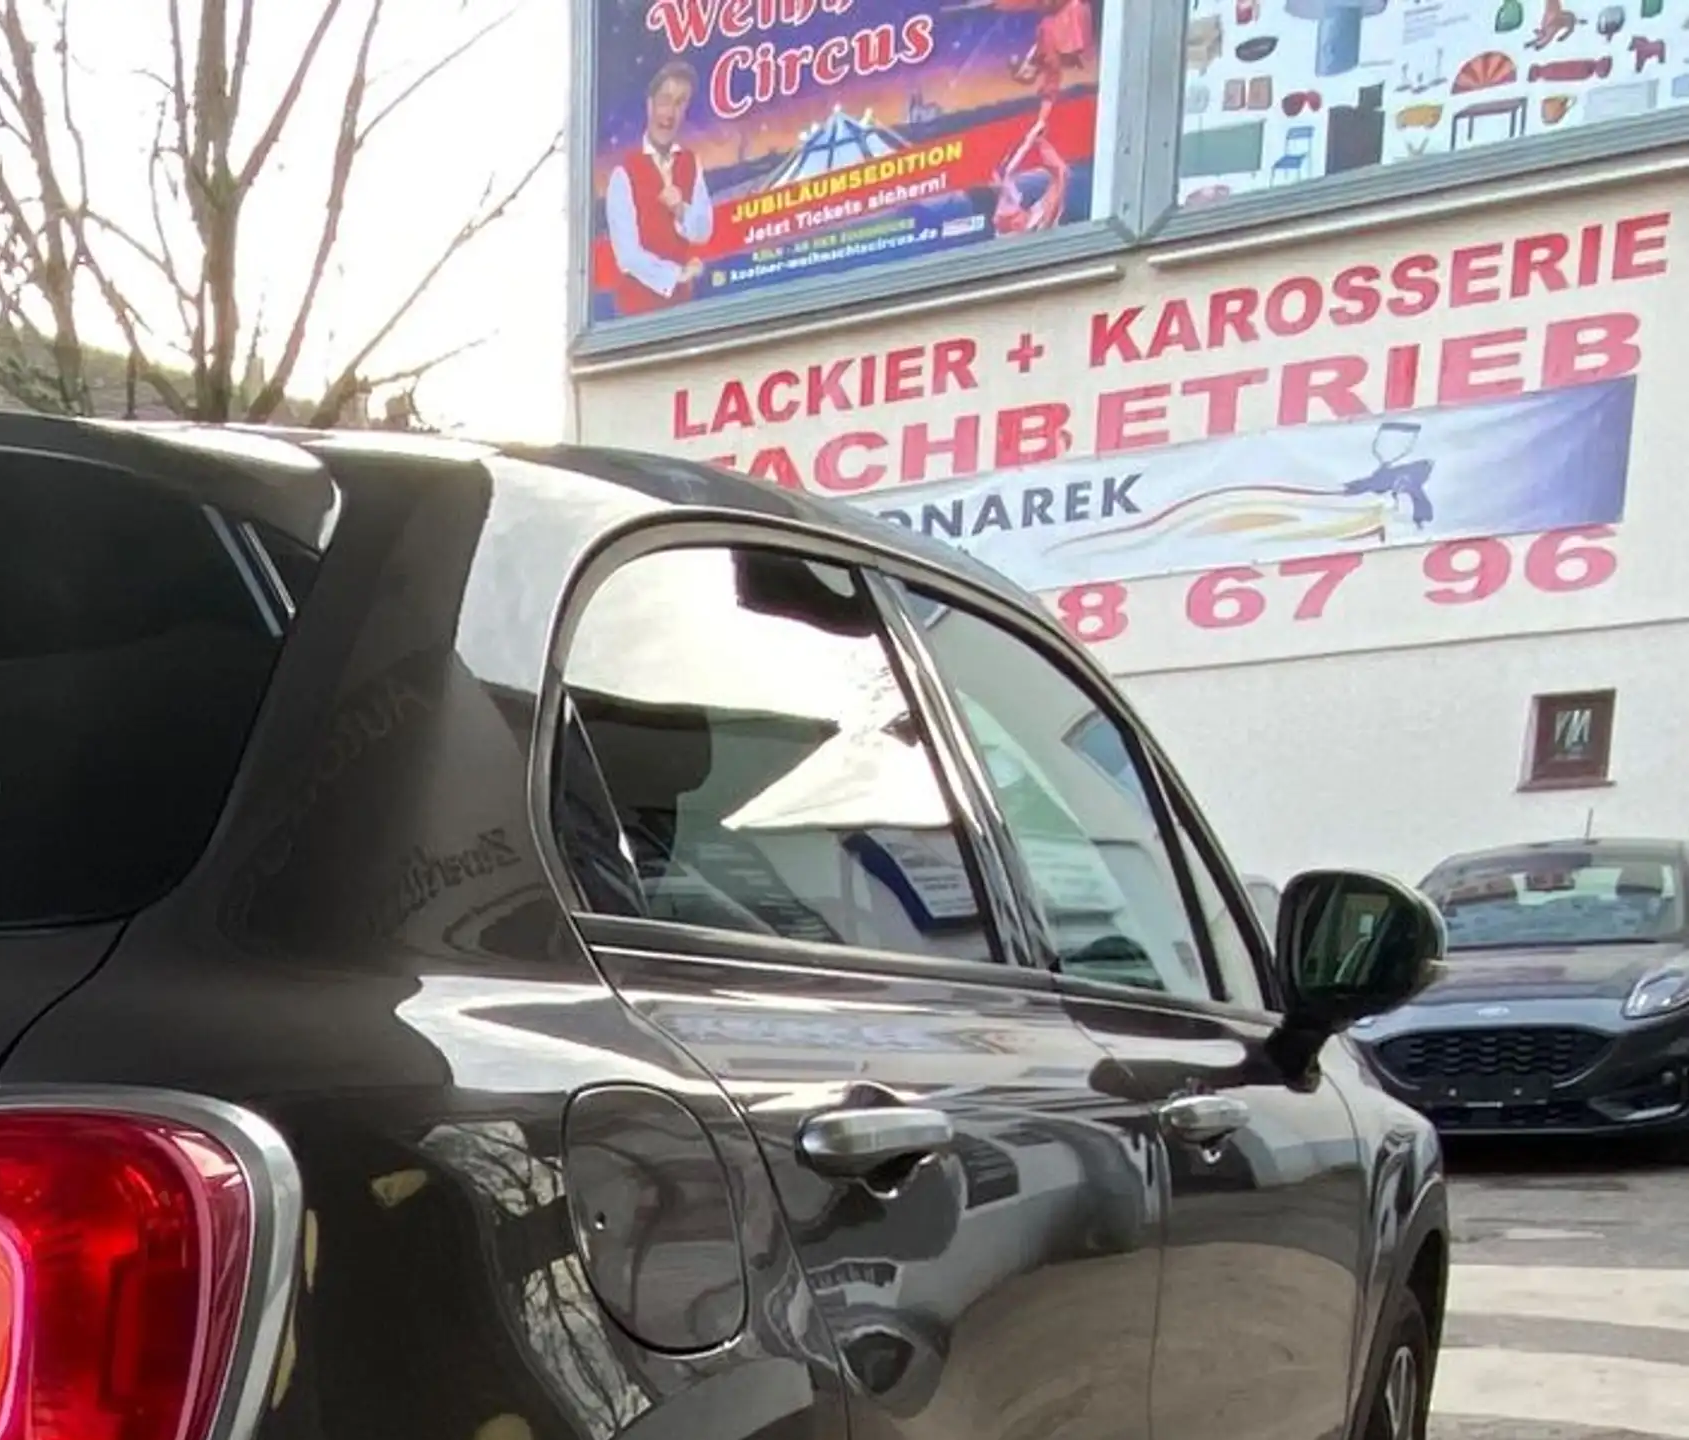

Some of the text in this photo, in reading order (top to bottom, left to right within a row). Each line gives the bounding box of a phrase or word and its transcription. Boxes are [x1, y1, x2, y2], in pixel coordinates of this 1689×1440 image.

[710, 14, 933, 119] Circus
[744, 220, 791, 244] Jetzt
[794, 198, 862, 230] Tickets
[673, 213, 1671, 439] LACKIER + KAROSSERIE
[710, 312, 1642, 492] ACHBETRIEB
[1185, 552, 1364, 629] 67
[1422, 524, 1618, 604] 96
